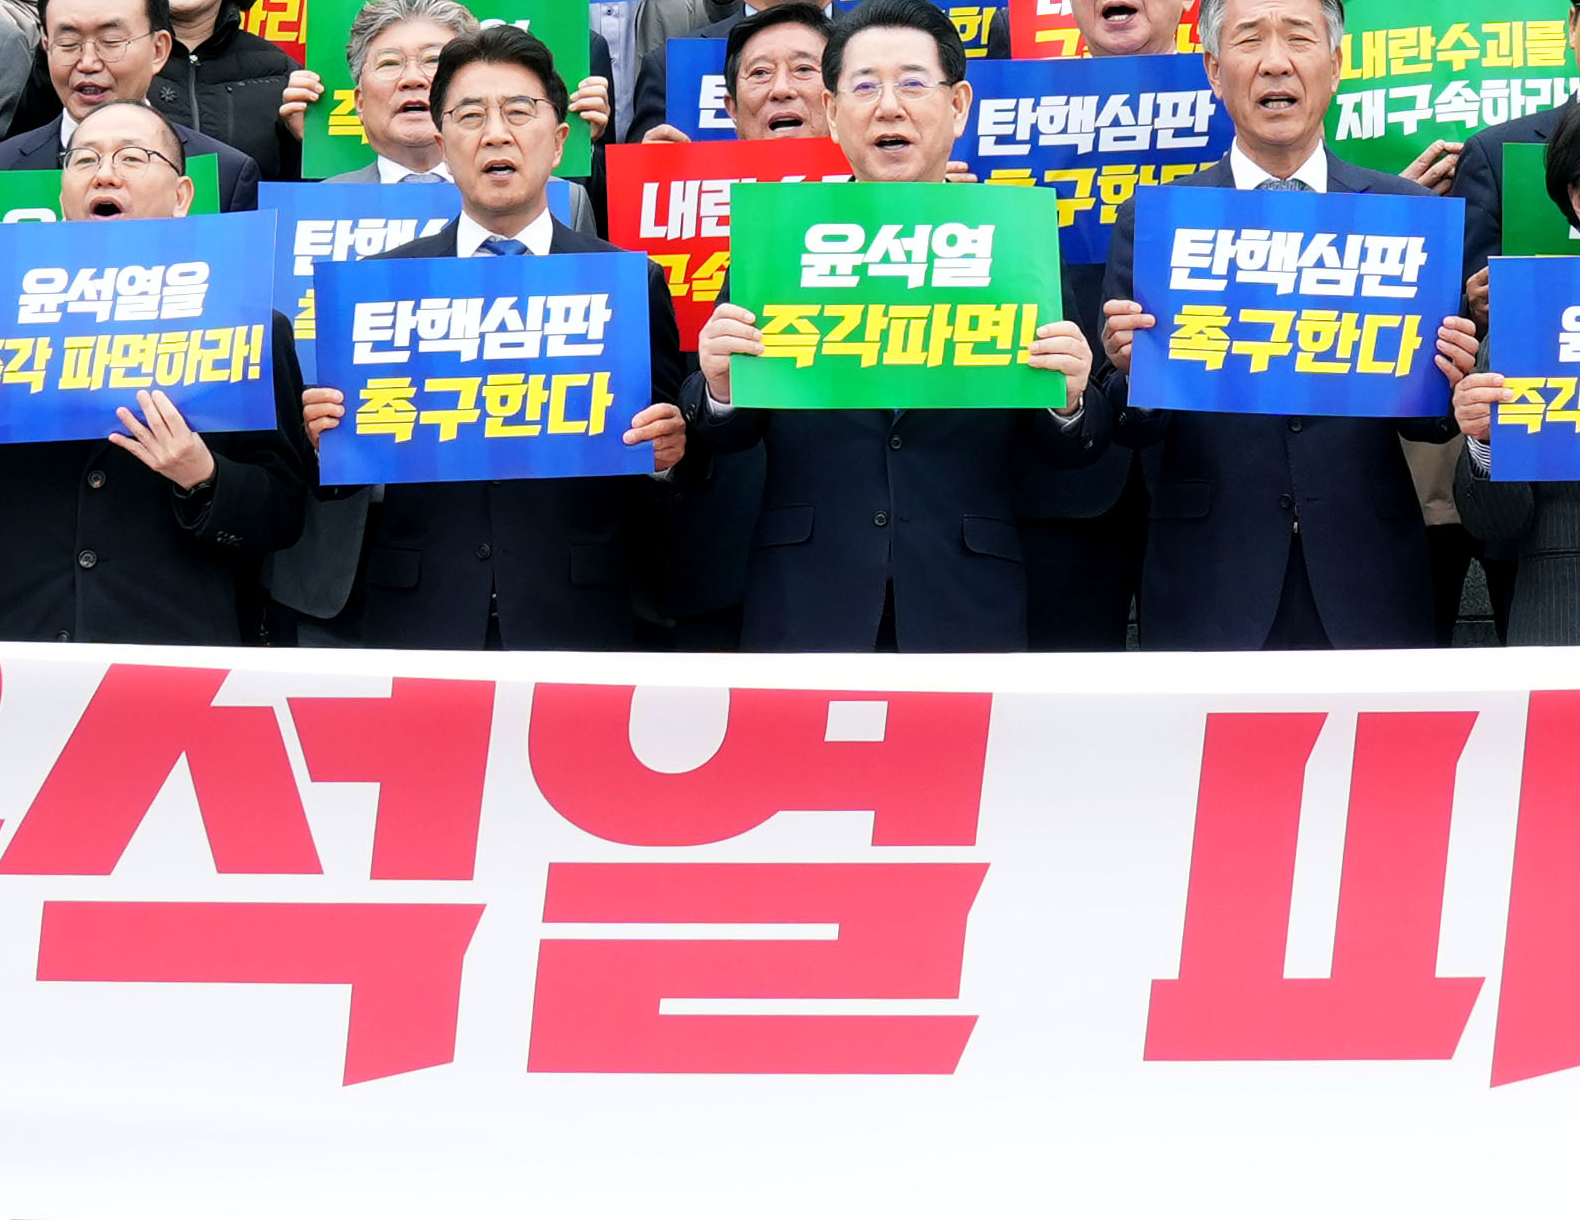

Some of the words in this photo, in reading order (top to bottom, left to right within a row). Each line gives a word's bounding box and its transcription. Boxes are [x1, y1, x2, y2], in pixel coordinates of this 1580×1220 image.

[1340, 20, 1567, 78] 내란수괴를
[977, 90, 1216, 157] 탄핵심판
[801, 223, 995, 288] 윤석열
[1169, 227, 1427, 297] 탄핵심판
[17, 261, 211, 321] 윤석열을
[58, 324, 261, 390] 파면하라!
[353, 295, 612, 363] 탄핵심판
[762, 304, 1038, 369] 즉각파면!
[1167, 307, 1422, 377] 촉구한다
[355, 369, 615, 445] 촉구한다
